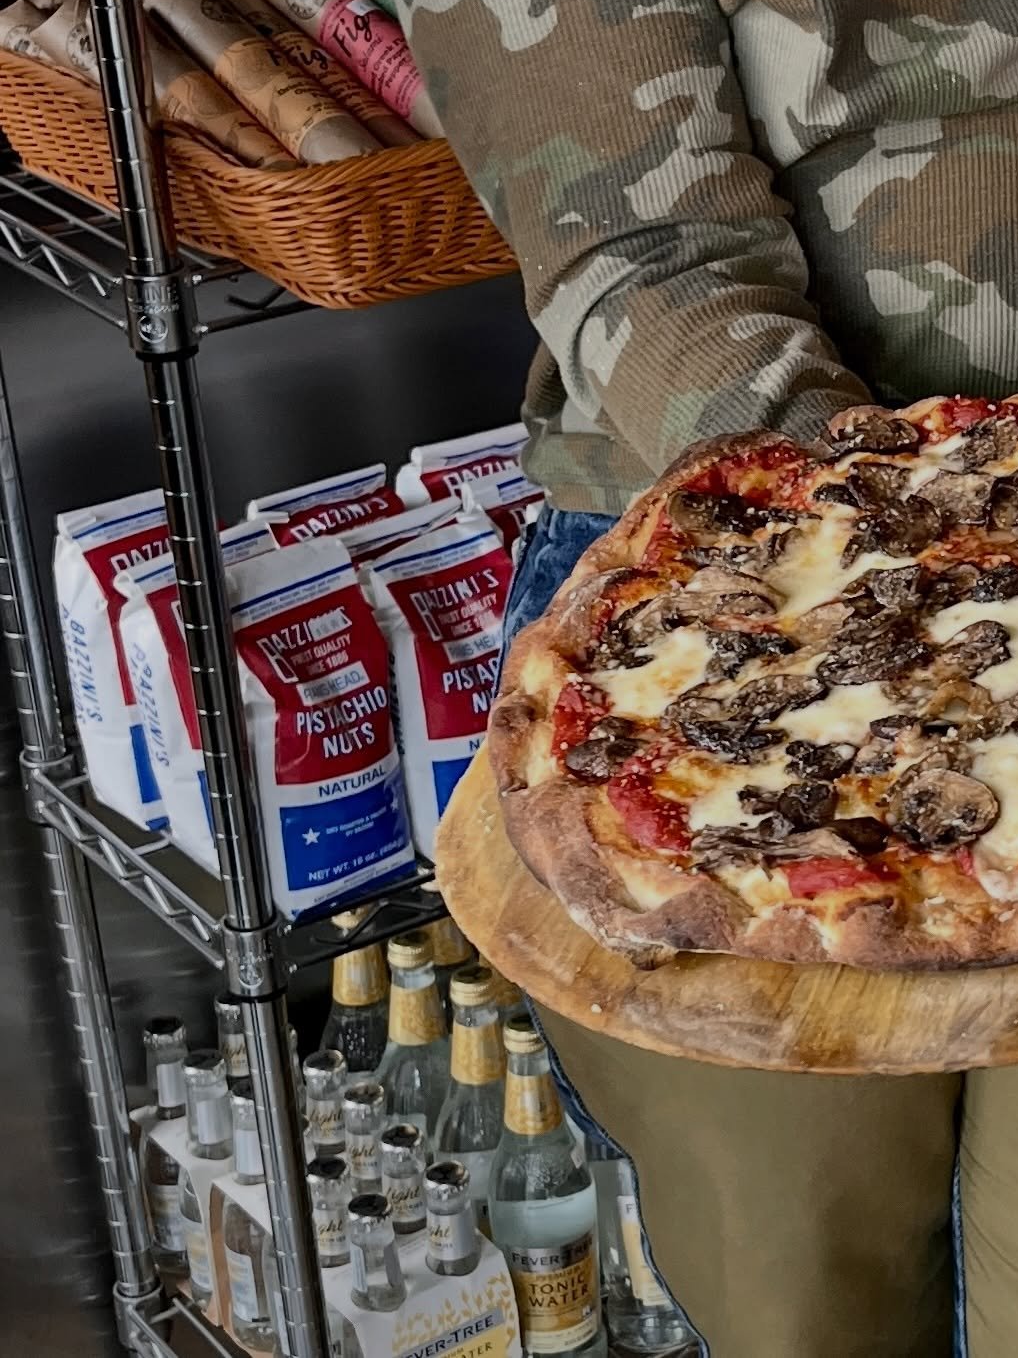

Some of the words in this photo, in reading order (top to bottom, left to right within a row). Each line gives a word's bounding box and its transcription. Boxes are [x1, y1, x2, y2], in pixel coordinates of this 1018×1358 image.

[333, 14, 372, 58] Fig
[409, 568, 499, 641] BAZZINI'S
[313, 634, 351, 659] QUALITY
[70, 619, 103, 723] BAZZINI'S
[296, 685, 388, 736] PISTACHIO
[322, 721, 376, 759] NUTS
[318, 764, 387, 798] NATURAL
[308, 867, 331, 882] NET
[332, 862, 351, 876] WT.
[528, 1285, 590, 1309] WATER
[529, 1274, 588, 1295] TONIC
